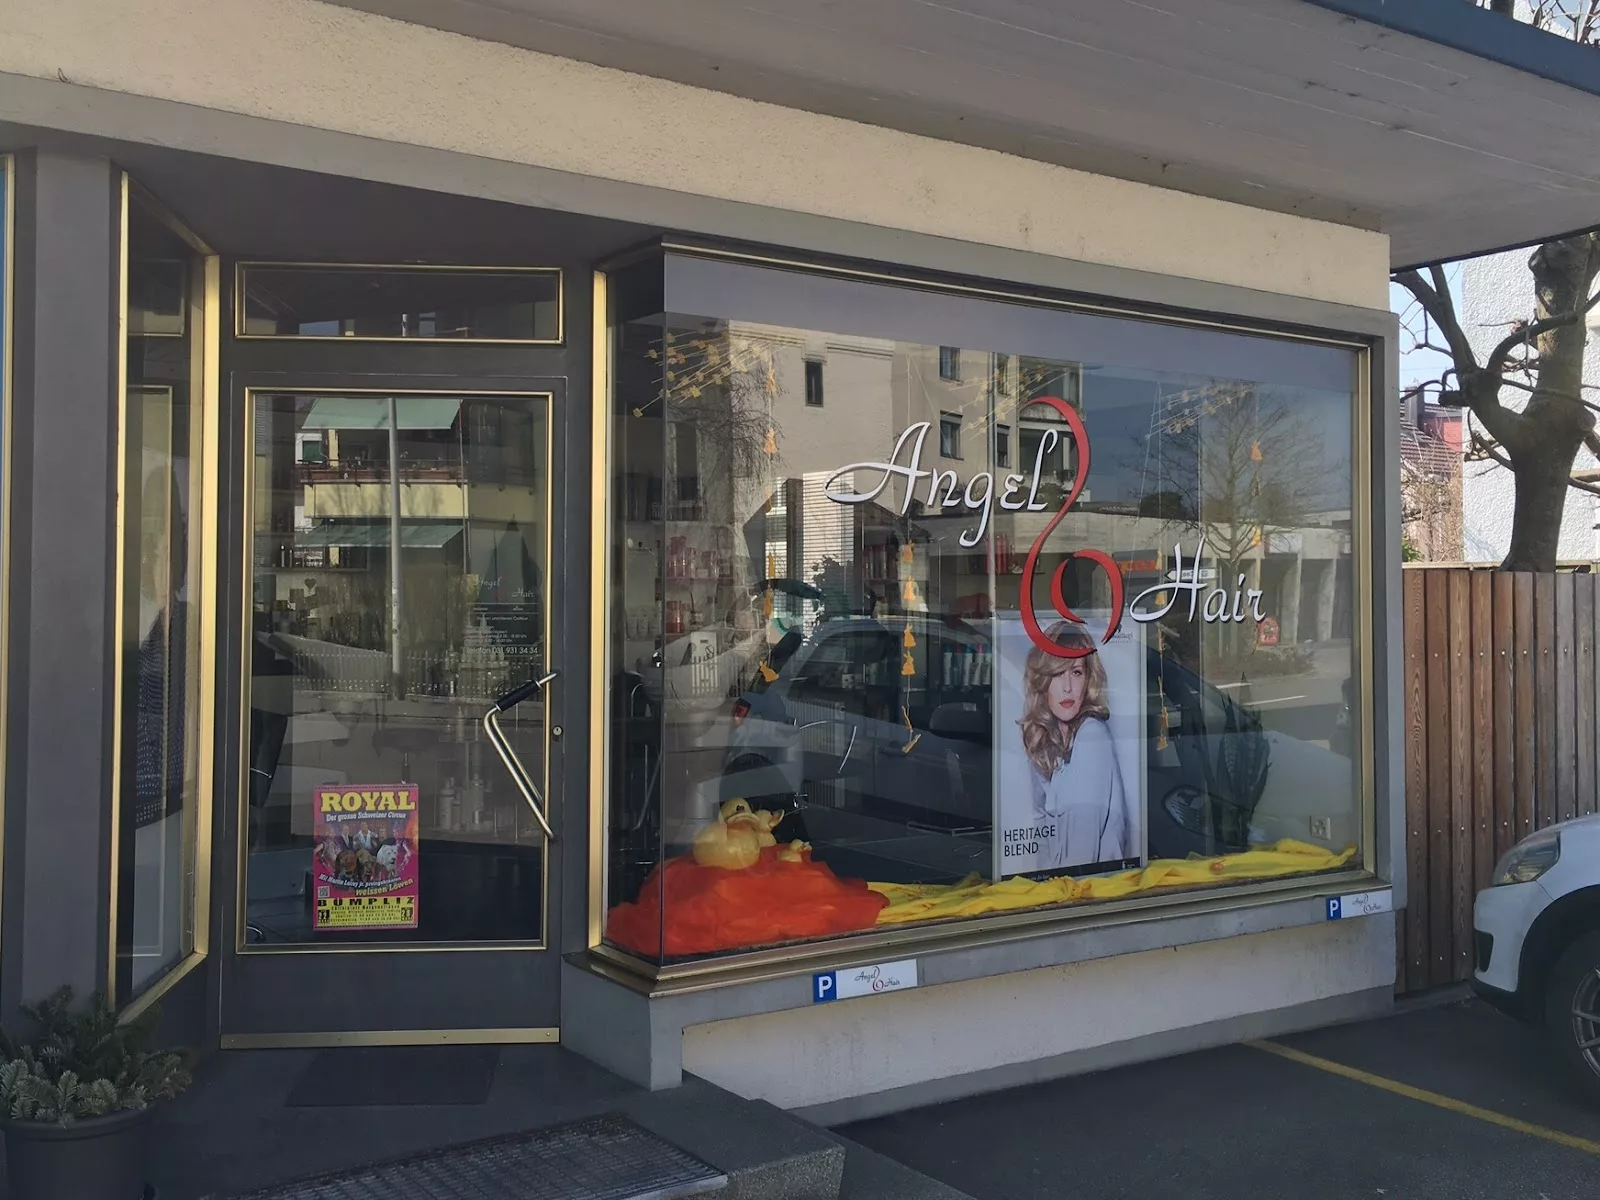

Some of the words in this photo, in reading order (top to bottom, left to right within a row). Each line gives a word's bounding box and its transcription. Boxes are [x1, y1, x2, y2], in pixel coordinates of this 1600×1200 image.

[823, 421, 1058, 548] Angel
[1129, 533, 1267, 622] Hair
[321, 791, 415, 812] ROYAL
[326, 813, 337, 822] Der
[338, 813, 357, 822] grosse
[388, 811, 406, 819] Circus
[1004, 825, 1056, 842] HERITAGE
[1004, 842, 1039, 857] BLEND
[1329, 899, 1339, 917] P
[855, 969, 876, 983] Angel
[818, 976, 832, 998] P
